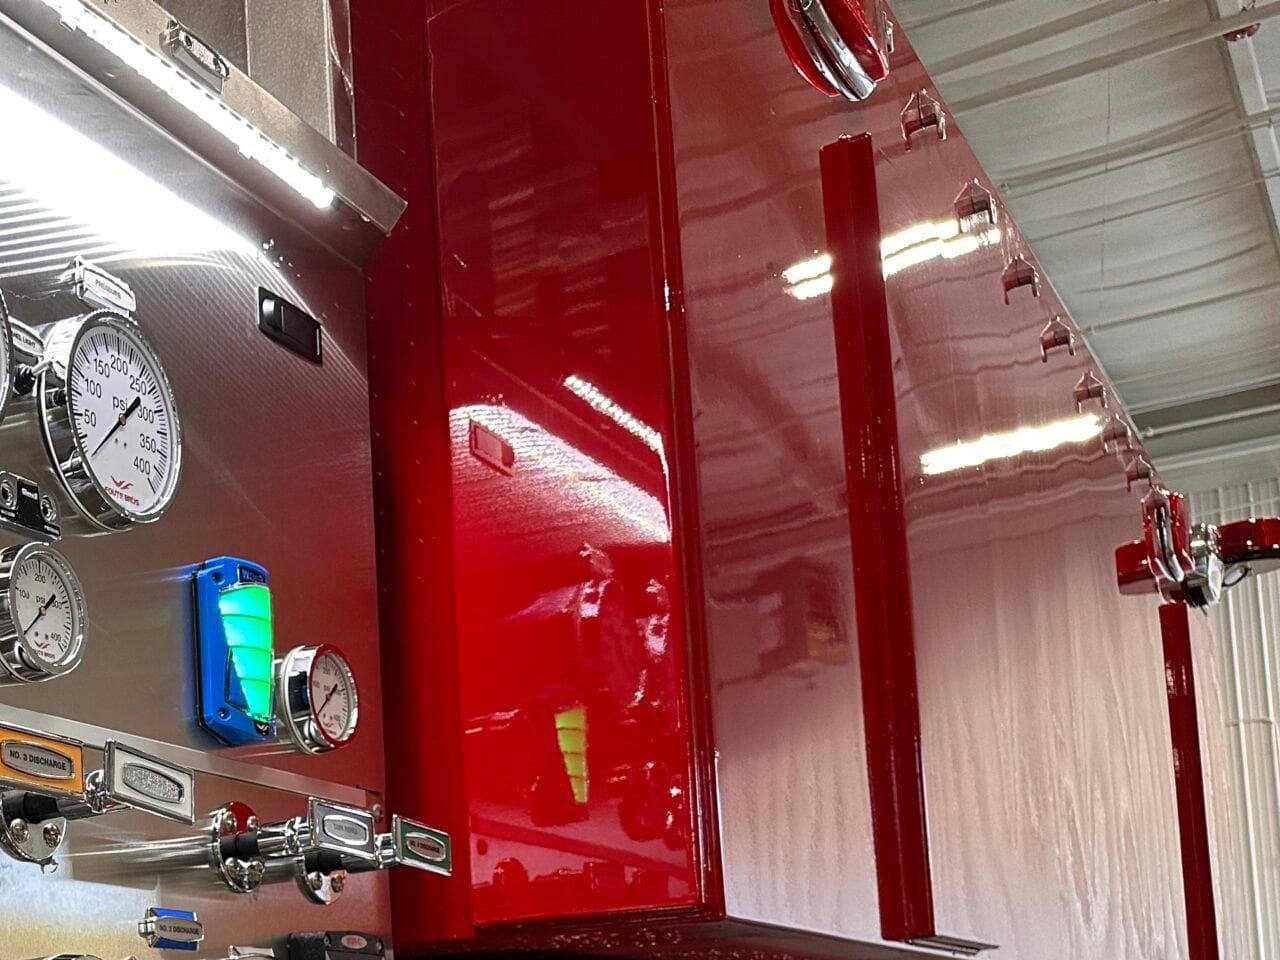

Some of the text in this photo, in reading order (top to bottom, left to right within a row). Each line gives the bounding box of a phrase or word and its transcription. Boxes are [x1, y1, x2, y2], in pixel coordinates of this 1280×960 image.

[93, 358, 109, 378] 150
[110, 354, 128, 375] 200
[85, 378, 101, 398] 100
[130, 375, 146, 395] 250
[112, 396, 129, 411] psi
[84, 409, 97, 427] 50
[137, 405, 154, 424] 300
[139, 433, 156, 453] 350
[133, 456, 150, 475] 400
[34, 573, 46, 584] 200
[36, 595, 46, 604] psi
[50, 632, 62, 642] 400
[10, 750, 22, 760] NO.
[29, 755, 67, 771] DISCHARGE
[173, 926, 199, 935] DISCHARGE
